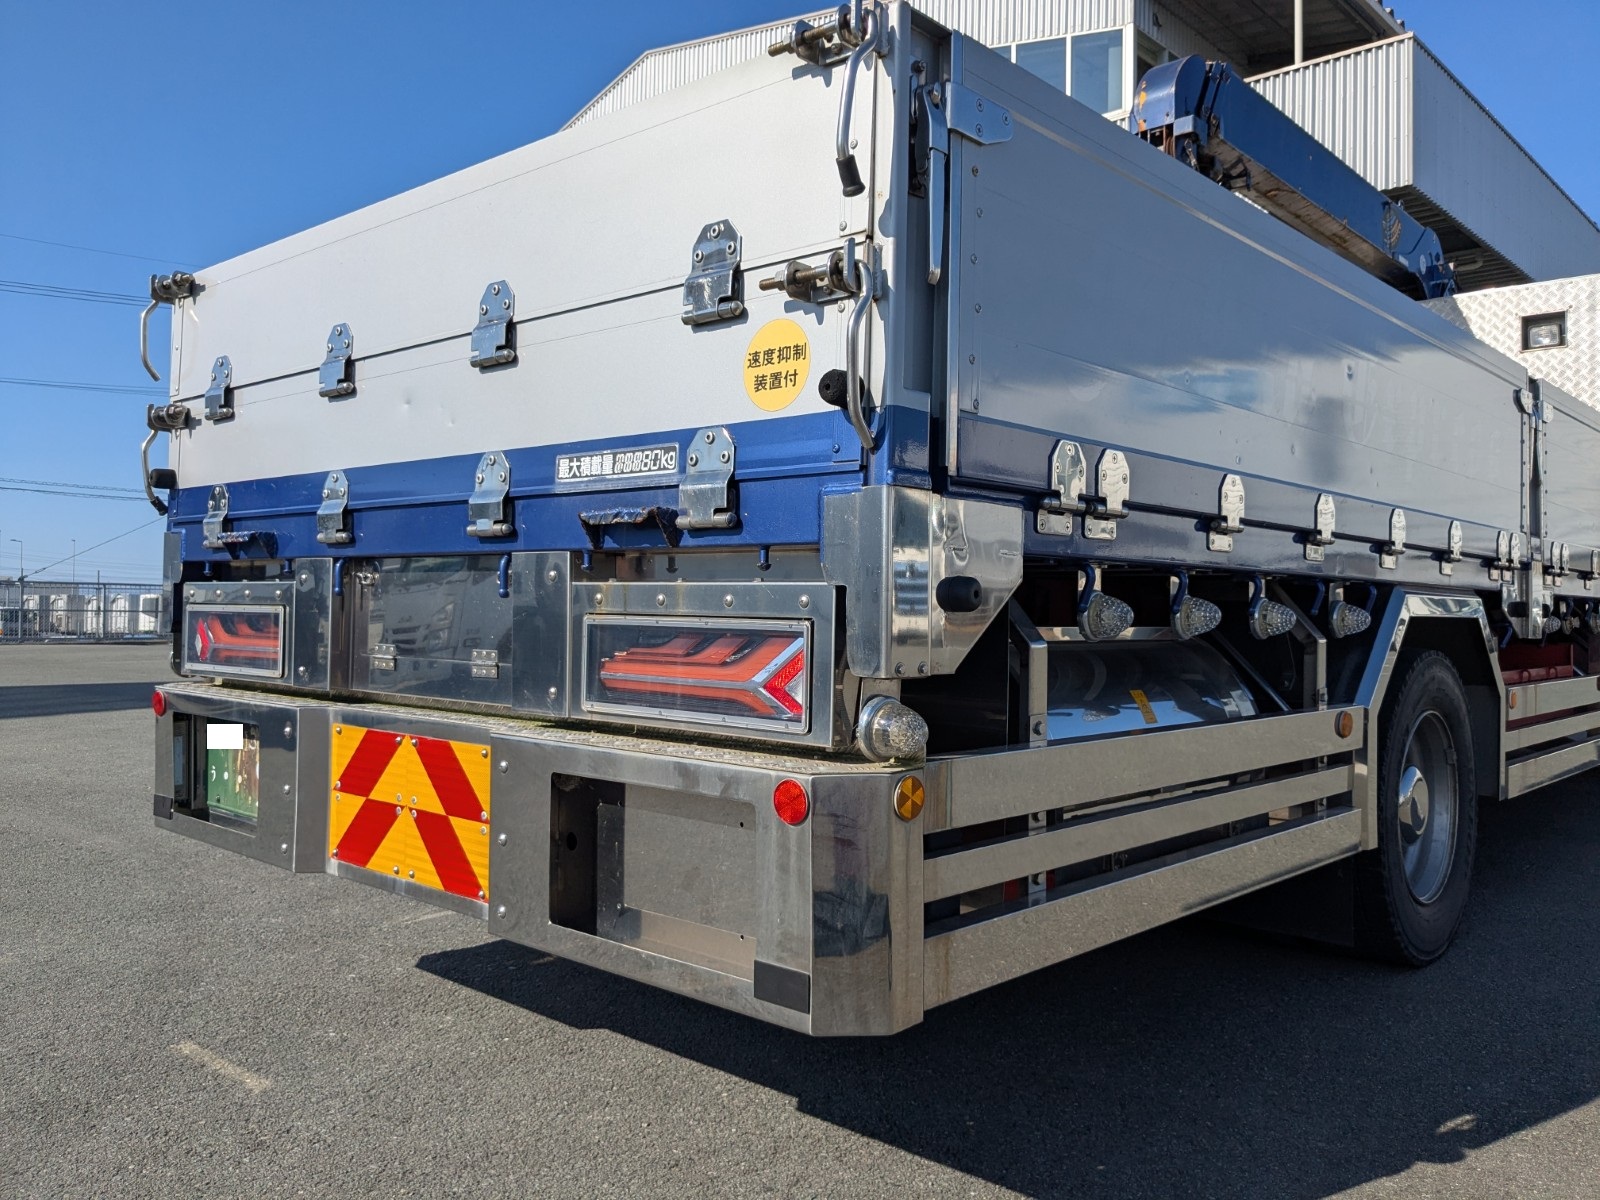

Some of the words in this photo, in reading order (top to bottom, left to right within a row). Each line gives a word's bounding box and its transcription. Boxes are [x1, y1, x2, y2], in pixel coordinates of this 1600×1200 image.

[747, 342, 807, 369] 速度抑制
[753, 368, 799, 393] 装置付
